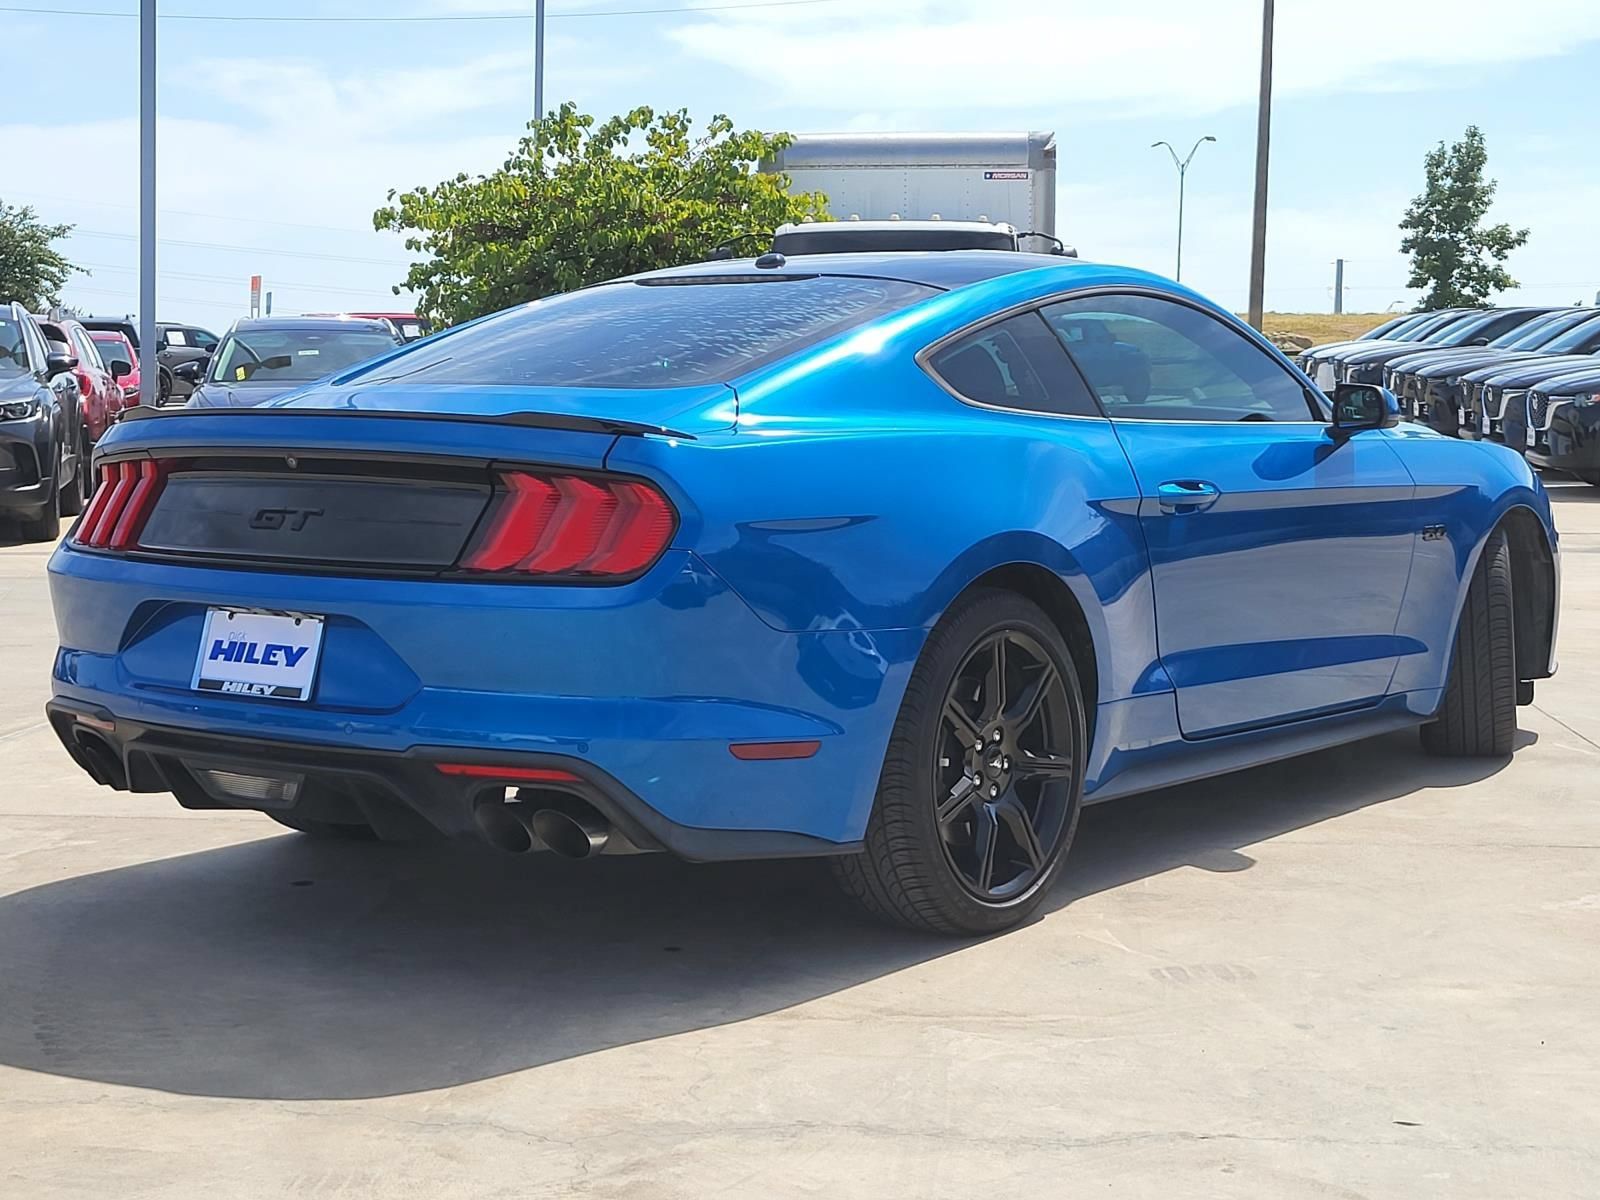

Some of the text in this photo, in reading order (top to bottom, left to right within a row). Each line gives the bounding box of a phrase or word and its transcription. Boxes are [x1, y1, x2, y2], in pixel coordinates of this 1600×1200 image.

[249, 508, 325, 532] GT
[209, 639, 309, 668] HILEY
[221, 681, 277, 695] HILEY
